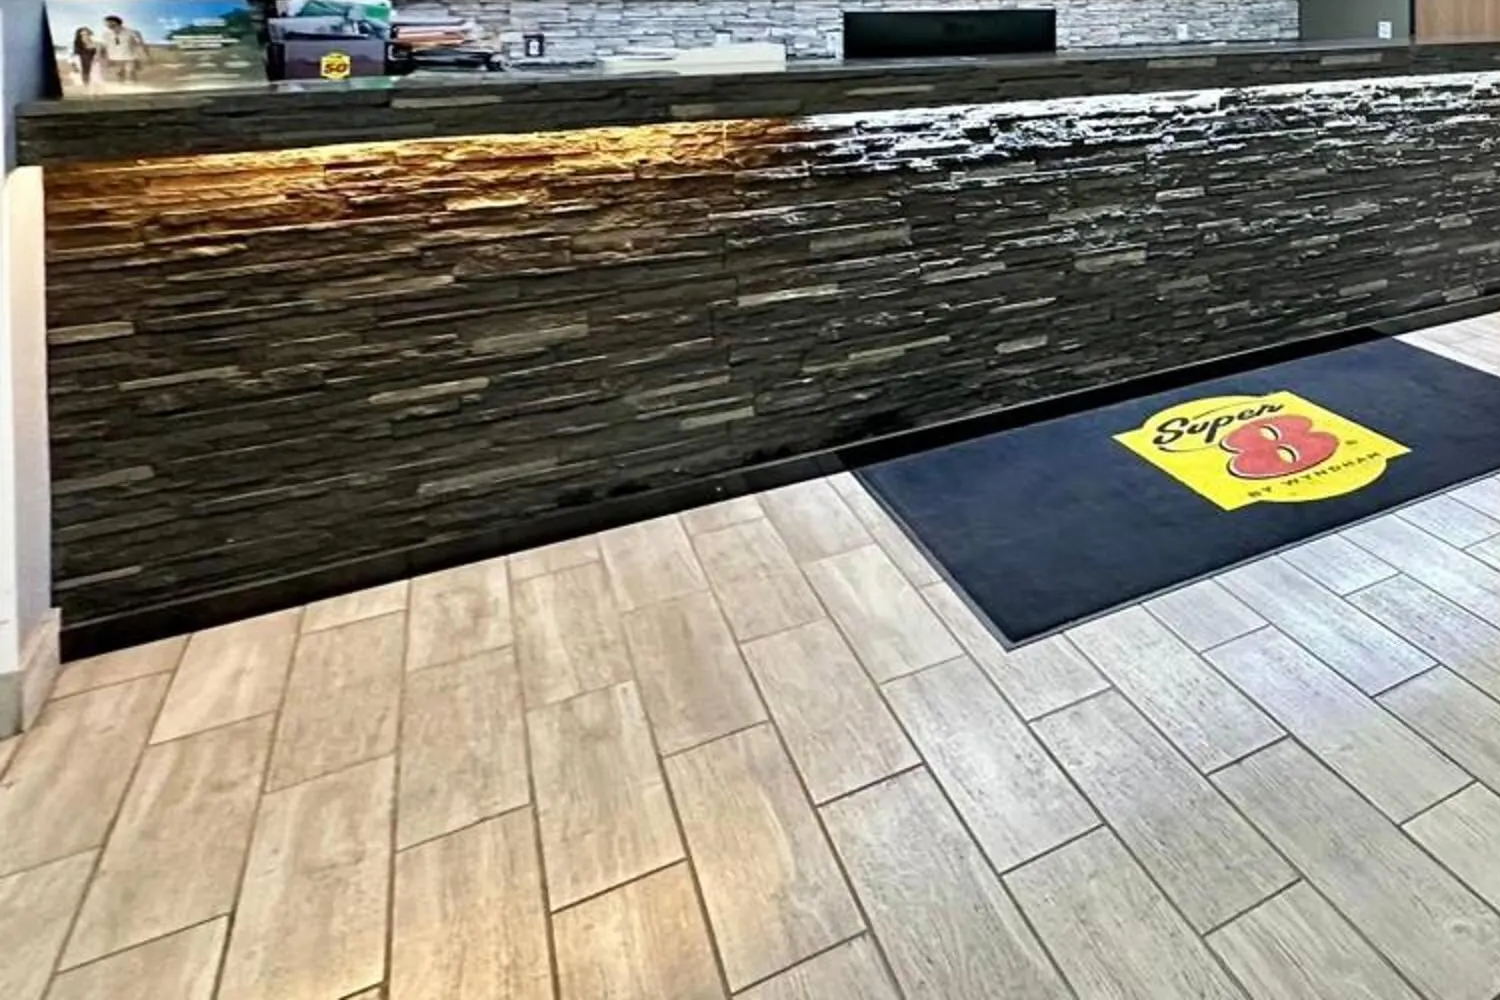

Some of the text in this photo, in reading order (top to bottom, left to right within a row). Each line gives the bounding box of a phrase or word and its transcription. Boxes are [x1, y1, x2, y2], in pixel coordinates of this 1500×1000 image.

[1154, 403, 1284, 444] Super
[1218, 414, 1341, 481] 8
[1248, 451, 1381, 498] BY WYNDHAM
